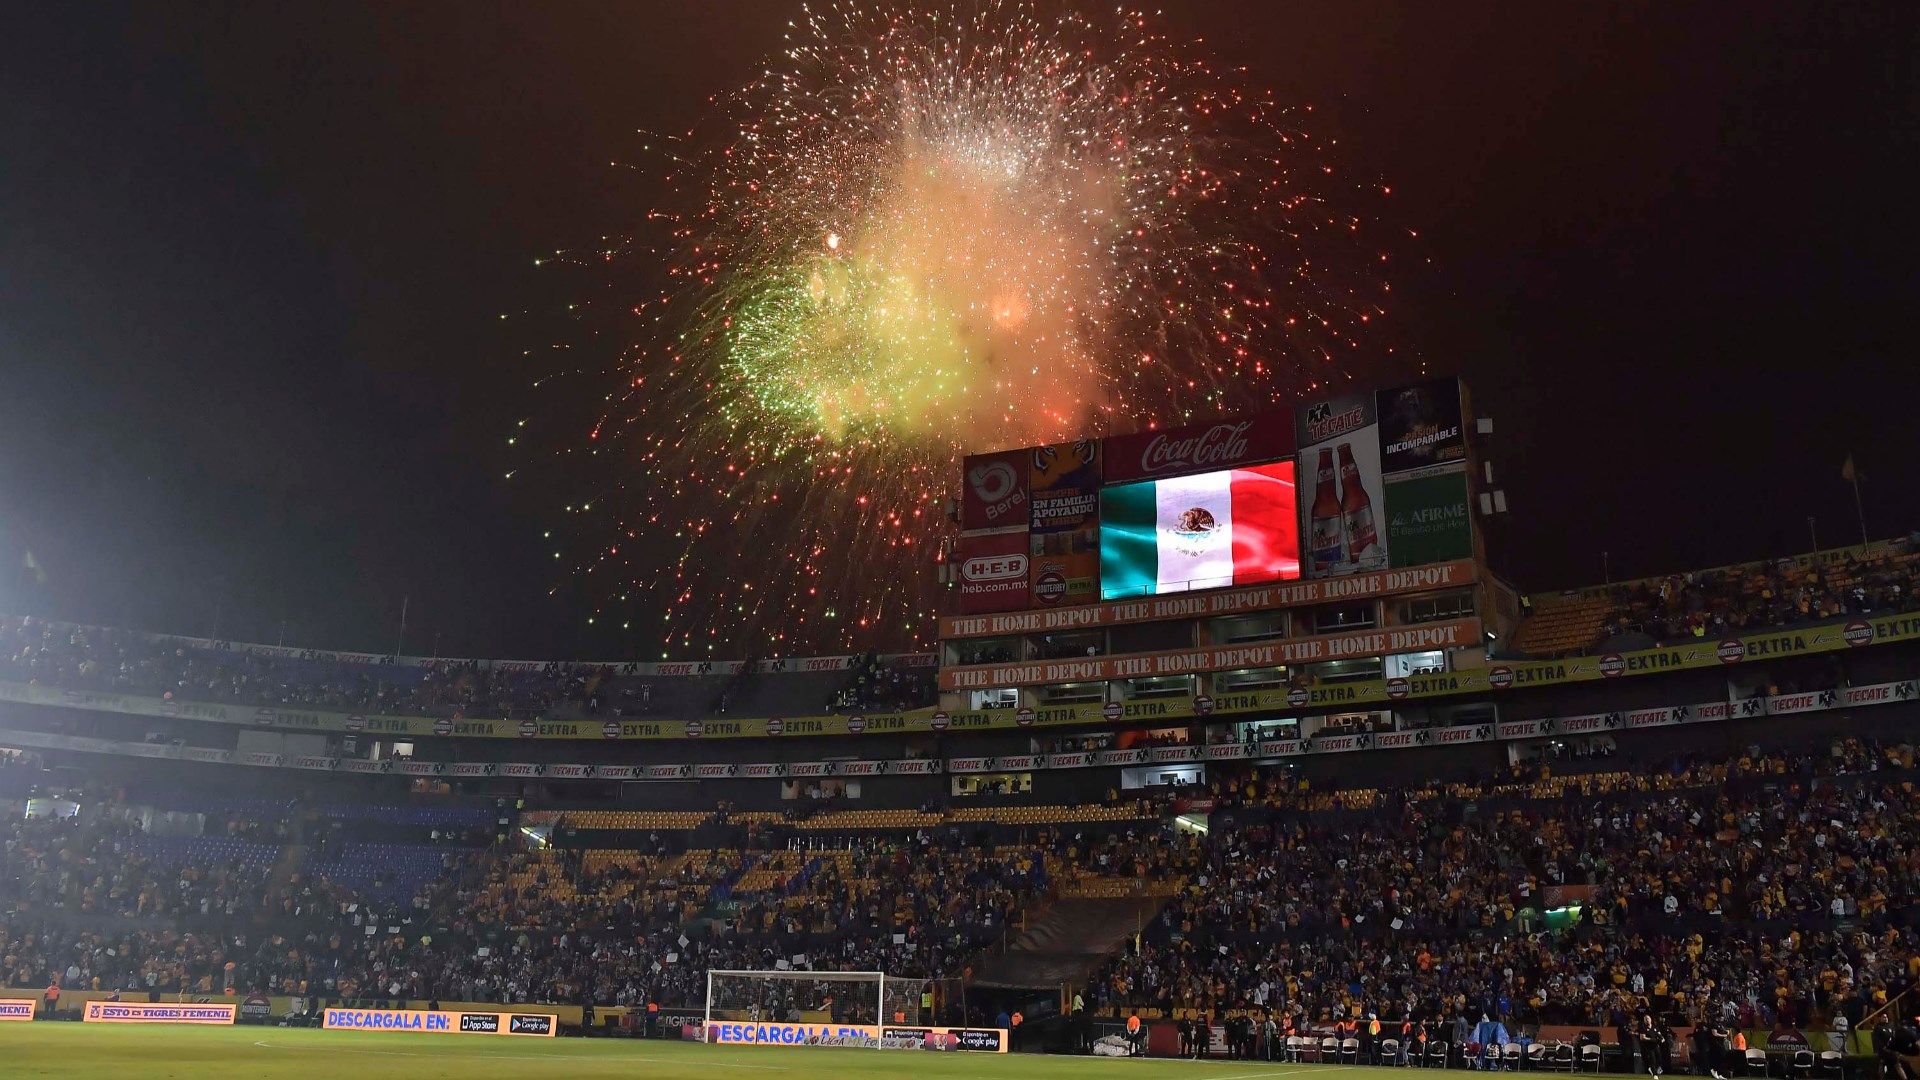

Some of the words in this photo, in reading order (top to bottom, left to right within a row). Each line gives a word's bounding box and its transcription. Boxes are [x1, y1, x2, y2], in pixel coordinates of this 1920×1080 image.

[1307, 408, 1363, 439] TECATE
[1142, 420, 1253, 471] Coca-Cola
[1386, 426, 1458, 455] INCOMPARABLE
[985, 486, 1028, 520] Berel
[1033, 500, 1048, 509] EN
[1050, 494, 1096, 508] FAMILIA
[1033, 503, 1094, 518] APOYANDO
[1411, 504, 1465, 524] AFIRME
[1032, 519, 1042, 528] A
[971, 560, 1021, 575] H-E-B
[962, 580, 1028, 594] heb.com.mx
[1278, 584, 1318, 603] THE
[1324, 575, 1380, 597] HOME
[1386, 566, 1452, 591] DEPOT
[1113, 604, 1148, 620] THE
[1155, 598, 1207, 616] HOME
[1211, 591, 1271, 611] DEPOT
[952, 619, 986, 634] THE
[992, 614, 1040, 631] HOME
[1046, 608, 1101, 627] DEPOT
[1844, 629, 1874, 640] MONTERREY
[1282, 642, 1322, 660] THE
[1328, 636, 1385, 655] HOME
[1391, 626, 1458, 648] DEPOT
[1747, 637, 1806, 656] EXTRA
[806, 659, 842, 670] TECATE
[1115, 658, 1150, 675] THE
[1157, 653, 1209, 671] HOME
[1215, 646, 1274, 666] DEPOT
[1628, 652, 1681, 670] EXTRA
[658, 664, 692, 676] TECATE
[952, 671, 987, 686] THE
[993, 666, 1041, 684] HOME
[1047, 661, 1104, 680] DEPOT
[1515, 666, 1565, 682] EXTRA
[1412, 677, 1458, 693] EXTRA
[1311, 687, 1355, 702] EXTRA
[1846, 687, 1890, 702] TECATE
[1215, 697, 1258, 709] EXTRA
[1772, 696, 1814, 711] TECATE
[1036, 709, 1076, 721] EXTRA
[1125, 703, 1166, 716] EXTRA
[1698, 704, 1738, 718] TECATE
[868, 717, 905, 728] EXTRA
[952, 714, 990, 725] EXTRA
[1630, 711, 1668, 724] TECATE
[368, 719, 407, 731] EXTRA
[540, 725, 577, 735] EXTRA
[623, 725, 660, 735] EXTRA
[704, 724, 740, 734] EXTRA
[786, 721, 822, 732] EXTRA
[1500, 724, 1536, 736] TECATE
[1563, 718, 1599, 730] TECATE
[1379, 734, 1412, 746] TECATE
[1437, 730, 1472, 741] TECATE
[1264, 742, 1295, 754] TECATE
[1320, 738, 1352, 750] TECATE
[1104, 749, 1133, 763] TECATE
[1157, 750, 1186, 759] TECATE
[1209, 746, 1239, 756] TECATE
[895, 762, 923, 771] TECATE
[953, 760, 980, 769] TECATE
[1003, 759, 1030, 767] TECATE
[1054, 756, 1082, 765] TECATE
[401, 763, 429, 772] TECATE
[453, 765, 481, 773] TECATE
[504, 766, 531, 774] TECATE
[553, 767, 580, 776] TECATE
[602, 768, 629, 776] TECATE
[651, 767, 677, 776] TECATE
[699, 767, 724, 775] TECATE
[745, 766, 772, 775] TECATE
[792, 765, 821, 774] TECATE
[845, 764, 873, 772] TECATE
[103, 1008, 130, 1016] ESTO
[143, 1009, 181, 1018] TIGRES
[183, 1010, 231, 1018] FEMENIL
[242, 1005, 270, 1014] MONTERREY
[329, 1011, 421, 1028] DESCARGALA
[427, 1014, 450, 1030] EN:
[469, 1021, 481, 1030] App
[522, 1022, 538, 1030] Google
[821, 1036, 845, 1045] LIGA
[985, 1038, 998, 1046] play
